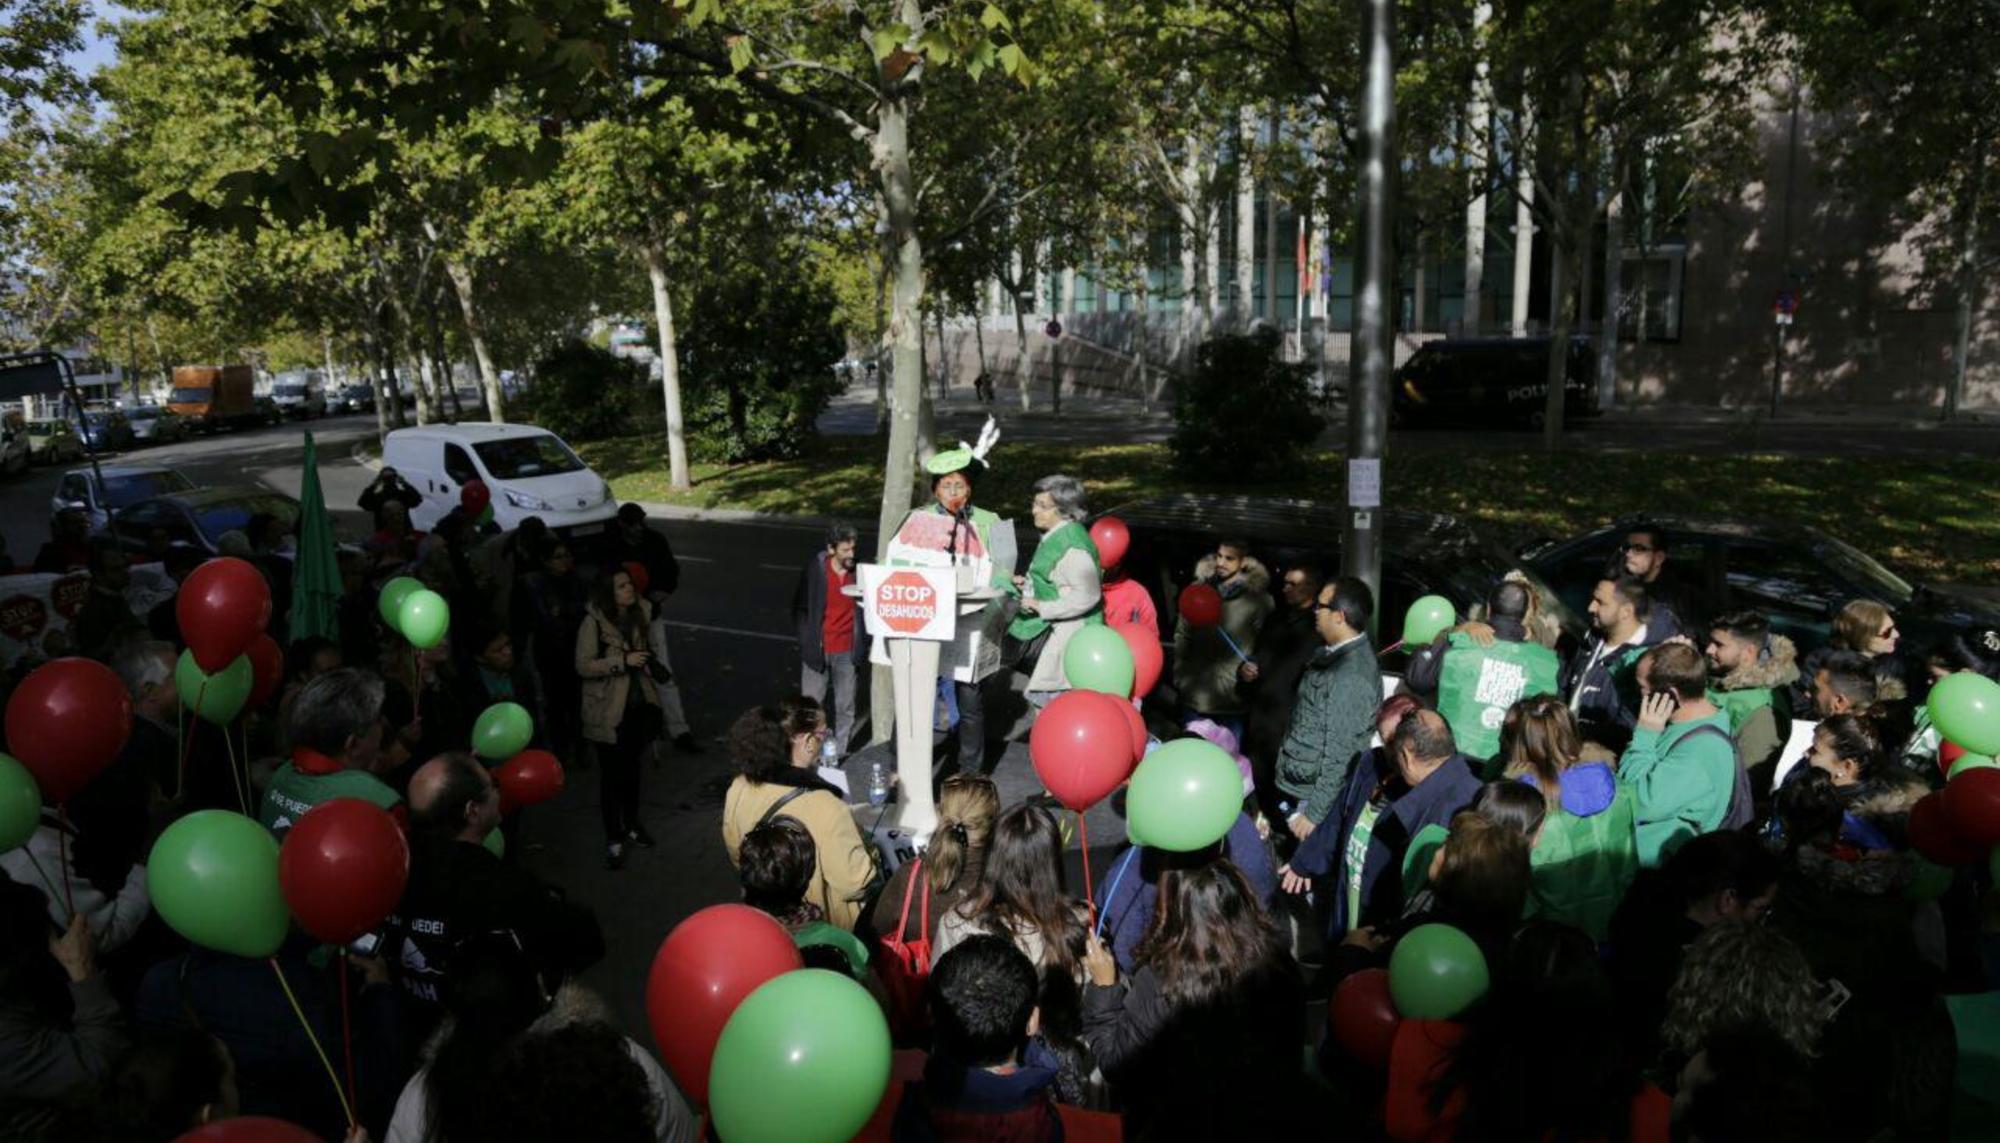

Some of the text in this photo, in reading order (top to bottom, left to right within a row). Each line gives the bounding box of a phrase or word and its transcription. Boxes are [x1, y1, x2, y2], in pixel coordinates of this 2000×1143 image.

[1507, 378, 1579, 403] POLIA
[881, 584, 932, 602] STOP
[879, 603, 934, 618] DESAHUCIOS
[286, 798, 313, 815] PUED
